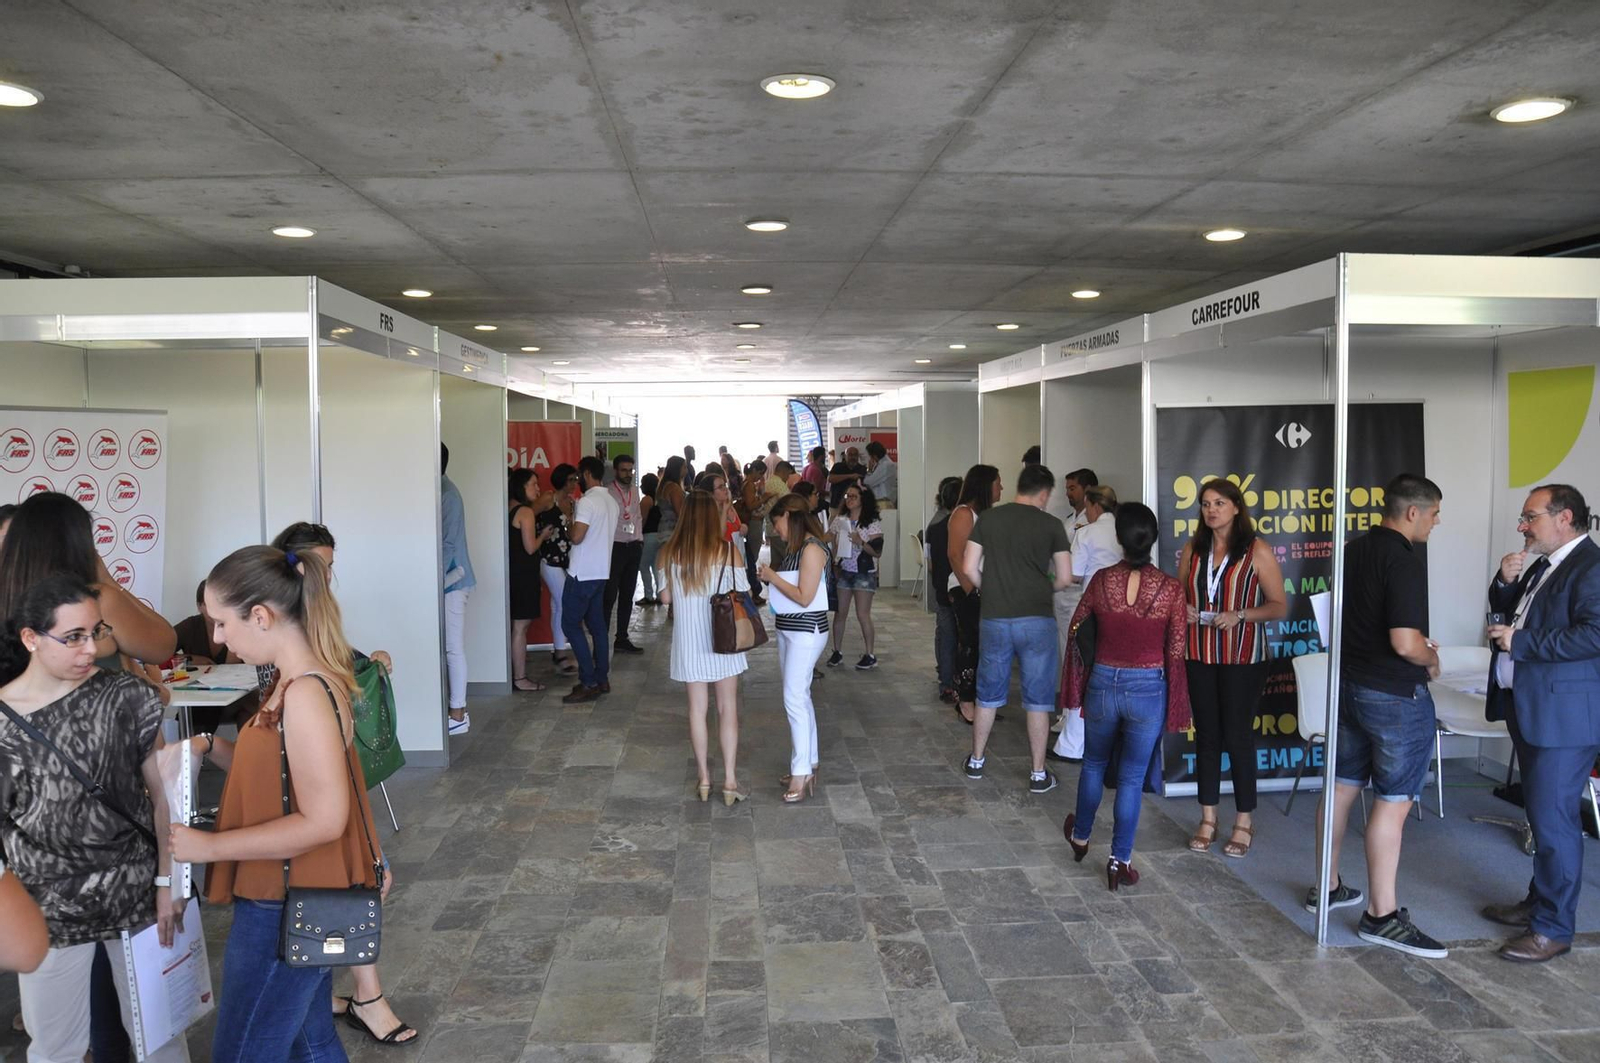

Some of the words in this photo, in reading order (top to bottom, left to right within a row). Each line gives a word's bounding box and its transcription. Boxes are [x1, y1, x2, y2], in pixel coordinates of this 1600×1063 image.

[1192, 291, 1260, 325] CARREFOUR
[380, 312, 394, 333] FRS
[1088, 330, 1120, 350] ARMADAS
[10, 449, 30, 458] FRS
[56, 449, 76, 457] FRS
[100, 448, 117, 456] FRS
[140, 448, 158, 456] FRS
[77, 493, 96, 502] FRS
[118, 492, 136, 500] FRS
[1263, 486, 1386, 511] DIRECOR
[97, 536, 115, 544] FRS
[135, 532, 156, 541] FRS
[1291, 551, 1303, 559] ES
[1304, 550, 1334, 558] REFLEJ
